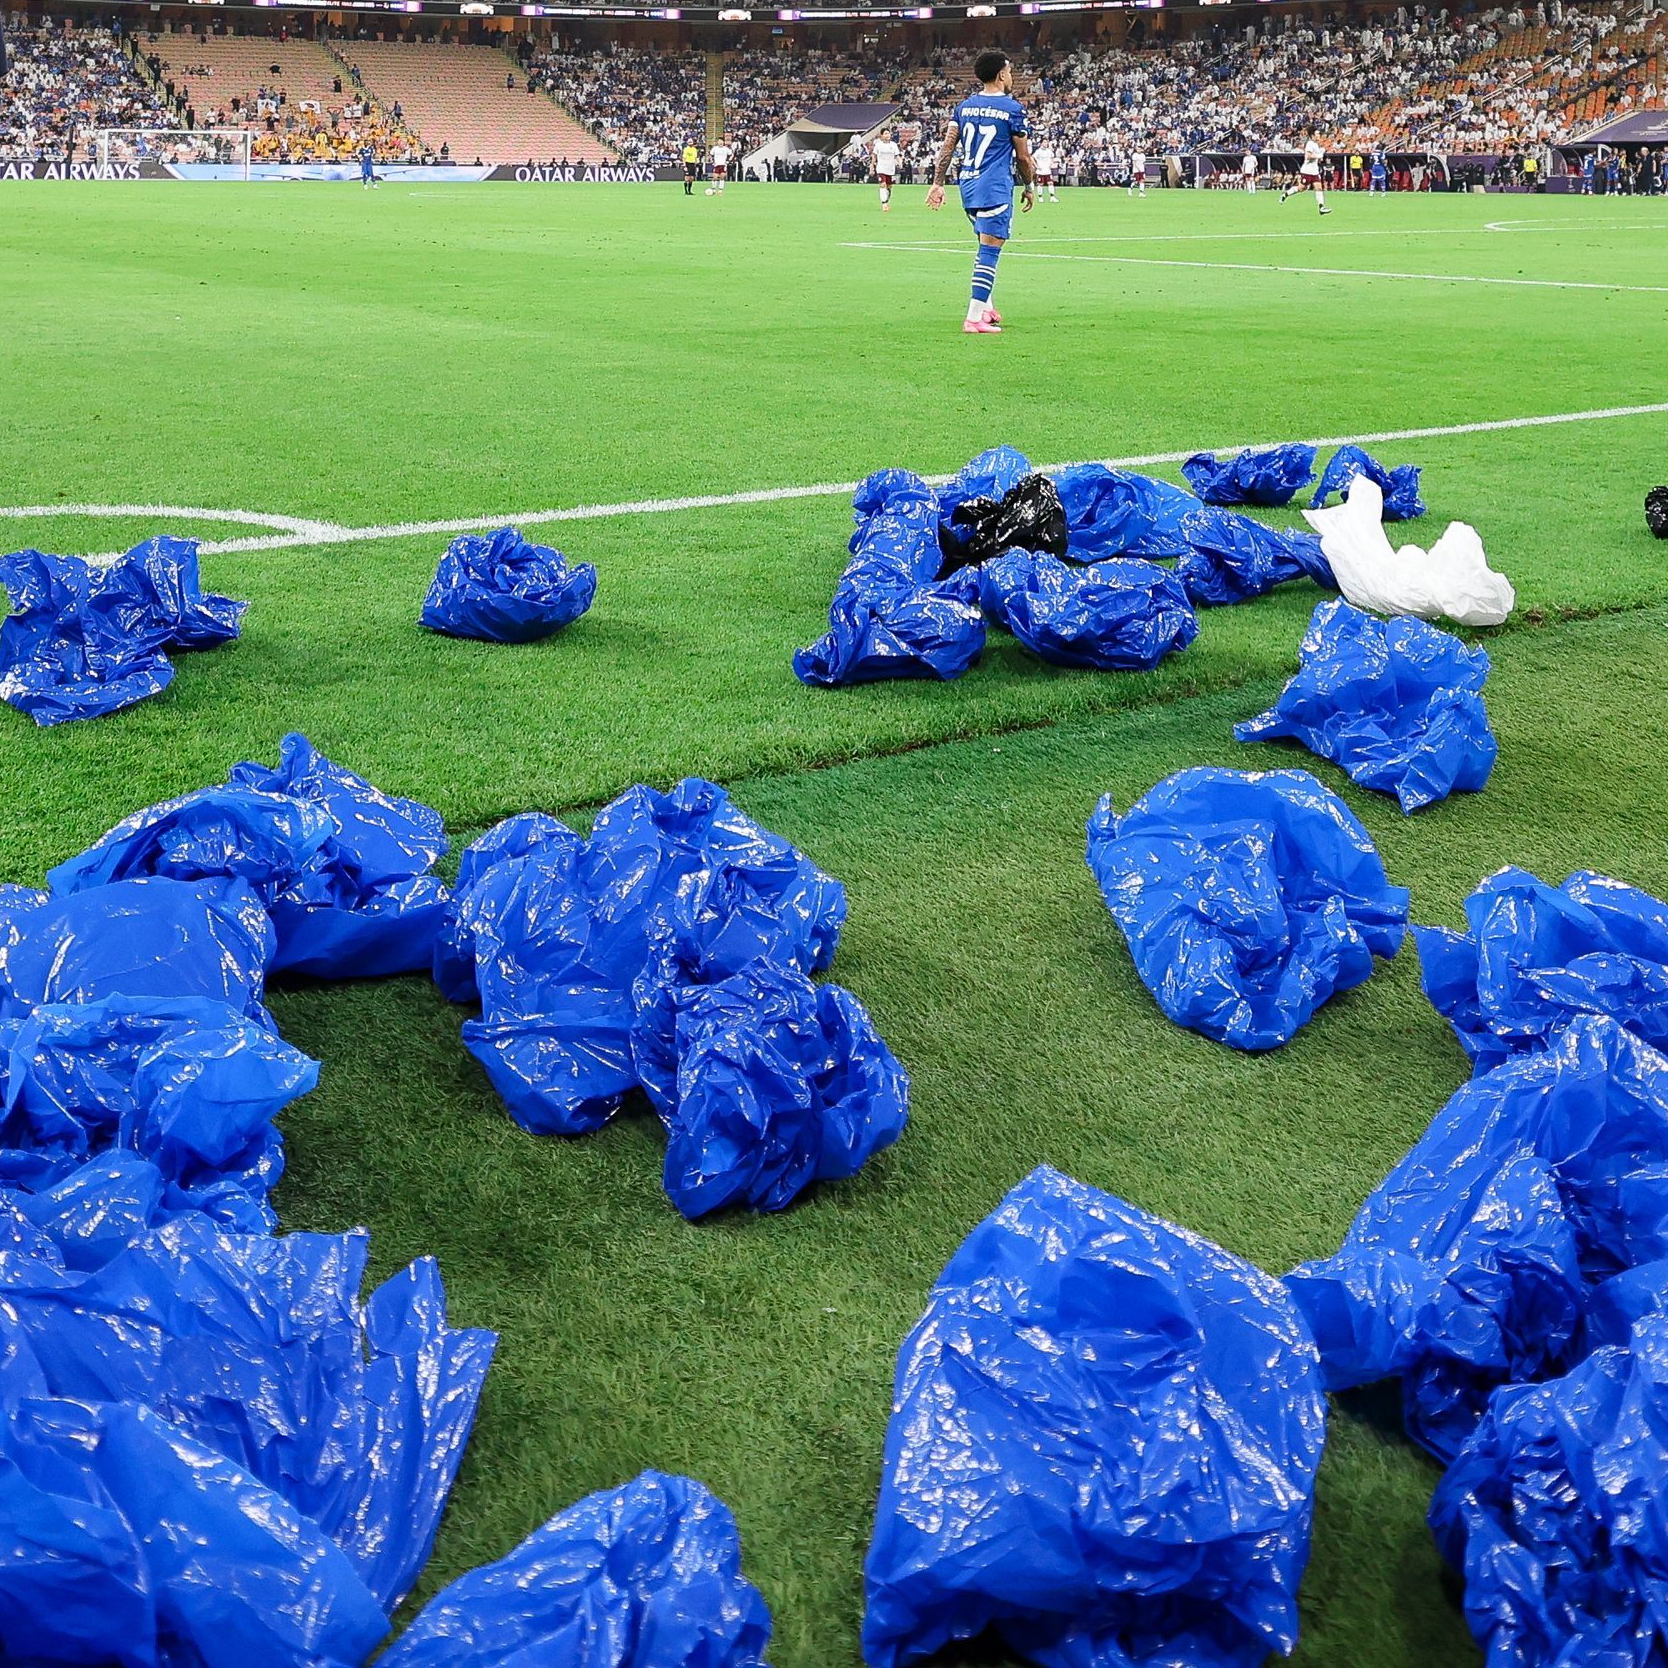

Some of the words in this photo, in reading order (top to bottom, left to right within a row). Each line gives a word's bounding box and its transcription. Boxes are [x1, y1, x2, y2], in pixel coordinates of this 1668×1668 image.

[980, 105, 1010, 121] CÉSAR
[962, 122, 997, 170] 27
[43, 162, 141, 180] AIRWAYS
[515, 167, 575, 183] QATAR
[582, 167, 655, 183] AIRWAYS
